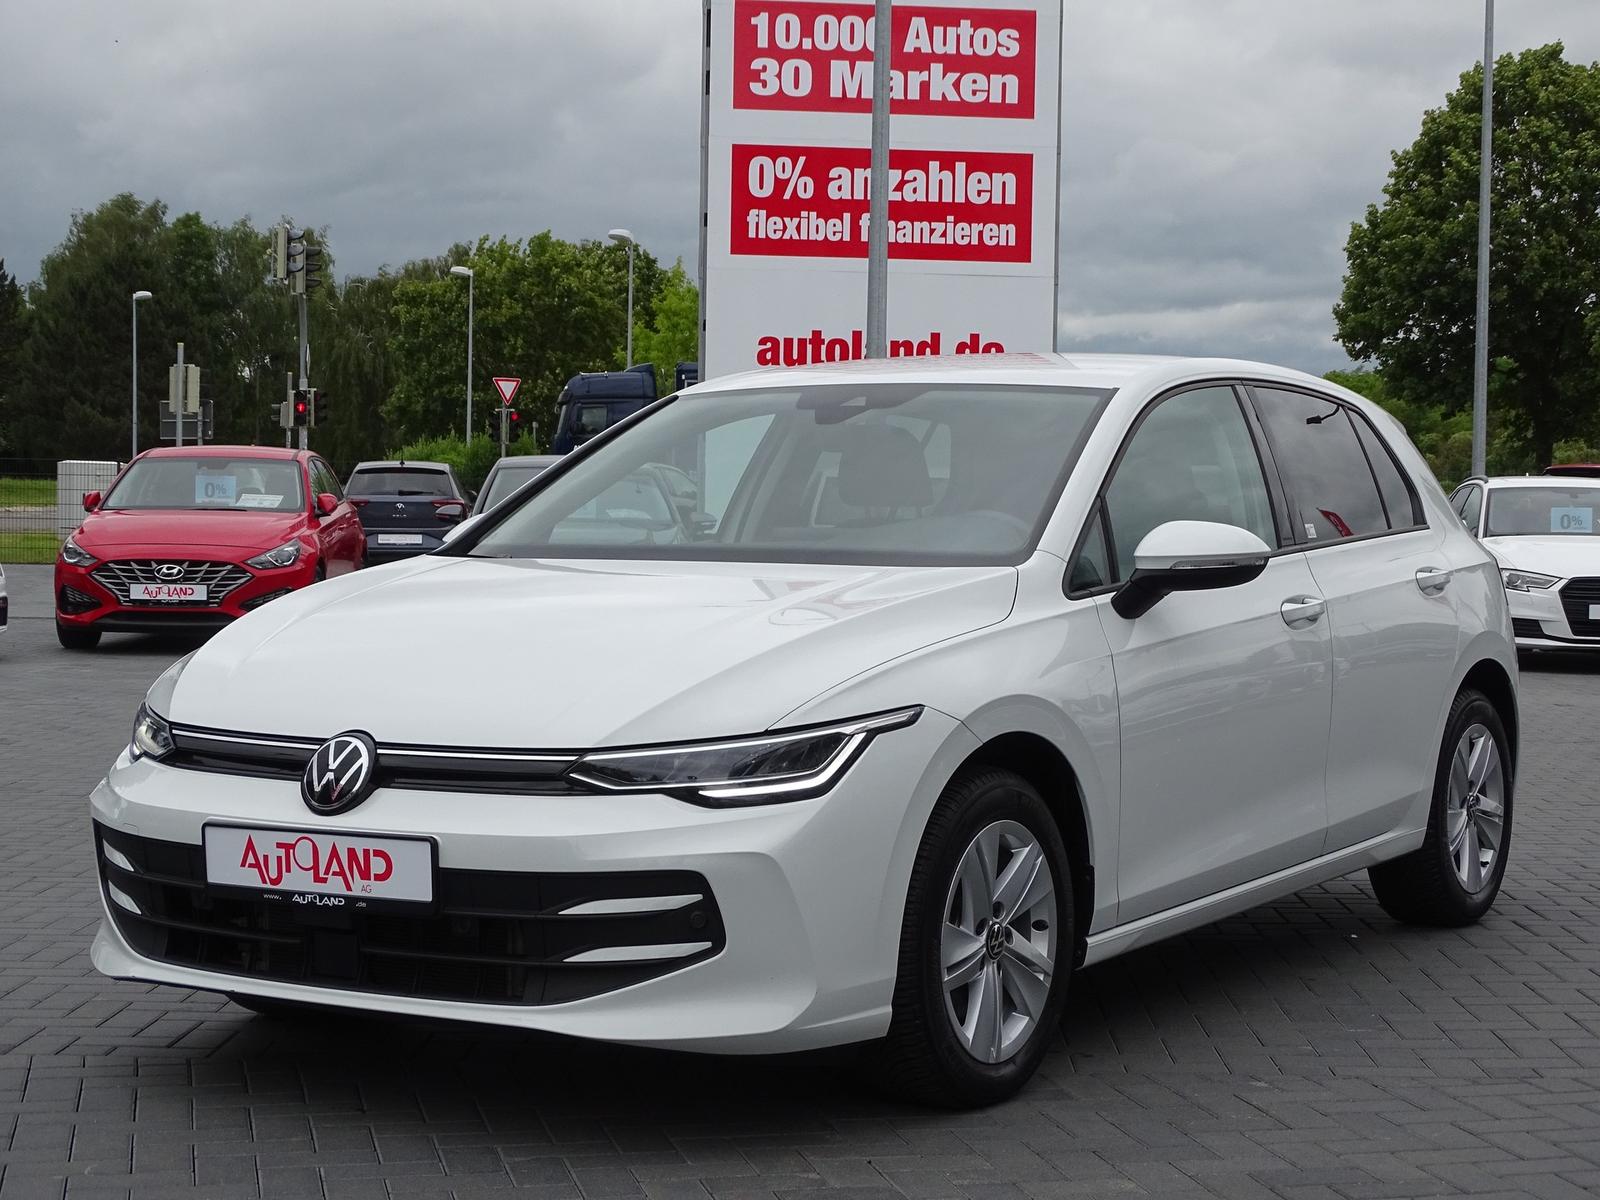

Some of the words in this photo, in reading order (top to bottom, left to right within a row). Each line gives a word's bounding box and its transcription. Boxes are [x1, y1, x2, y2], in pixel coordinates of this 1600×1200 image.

[903, 16, 1020, 57] Autos
[749, 57, 813, 97] 30
[747, 156, 815, 200] 0%
[827, 160, 1017, 205] anzahlen
[747, 209, 851, 241] flexibel
[859, 213, 1016, 246] fanzieren
[204, 482, 227, 498] 0%
[1560, 513, 1583, 530] 0%
[360, 884, 372, 894] AG
